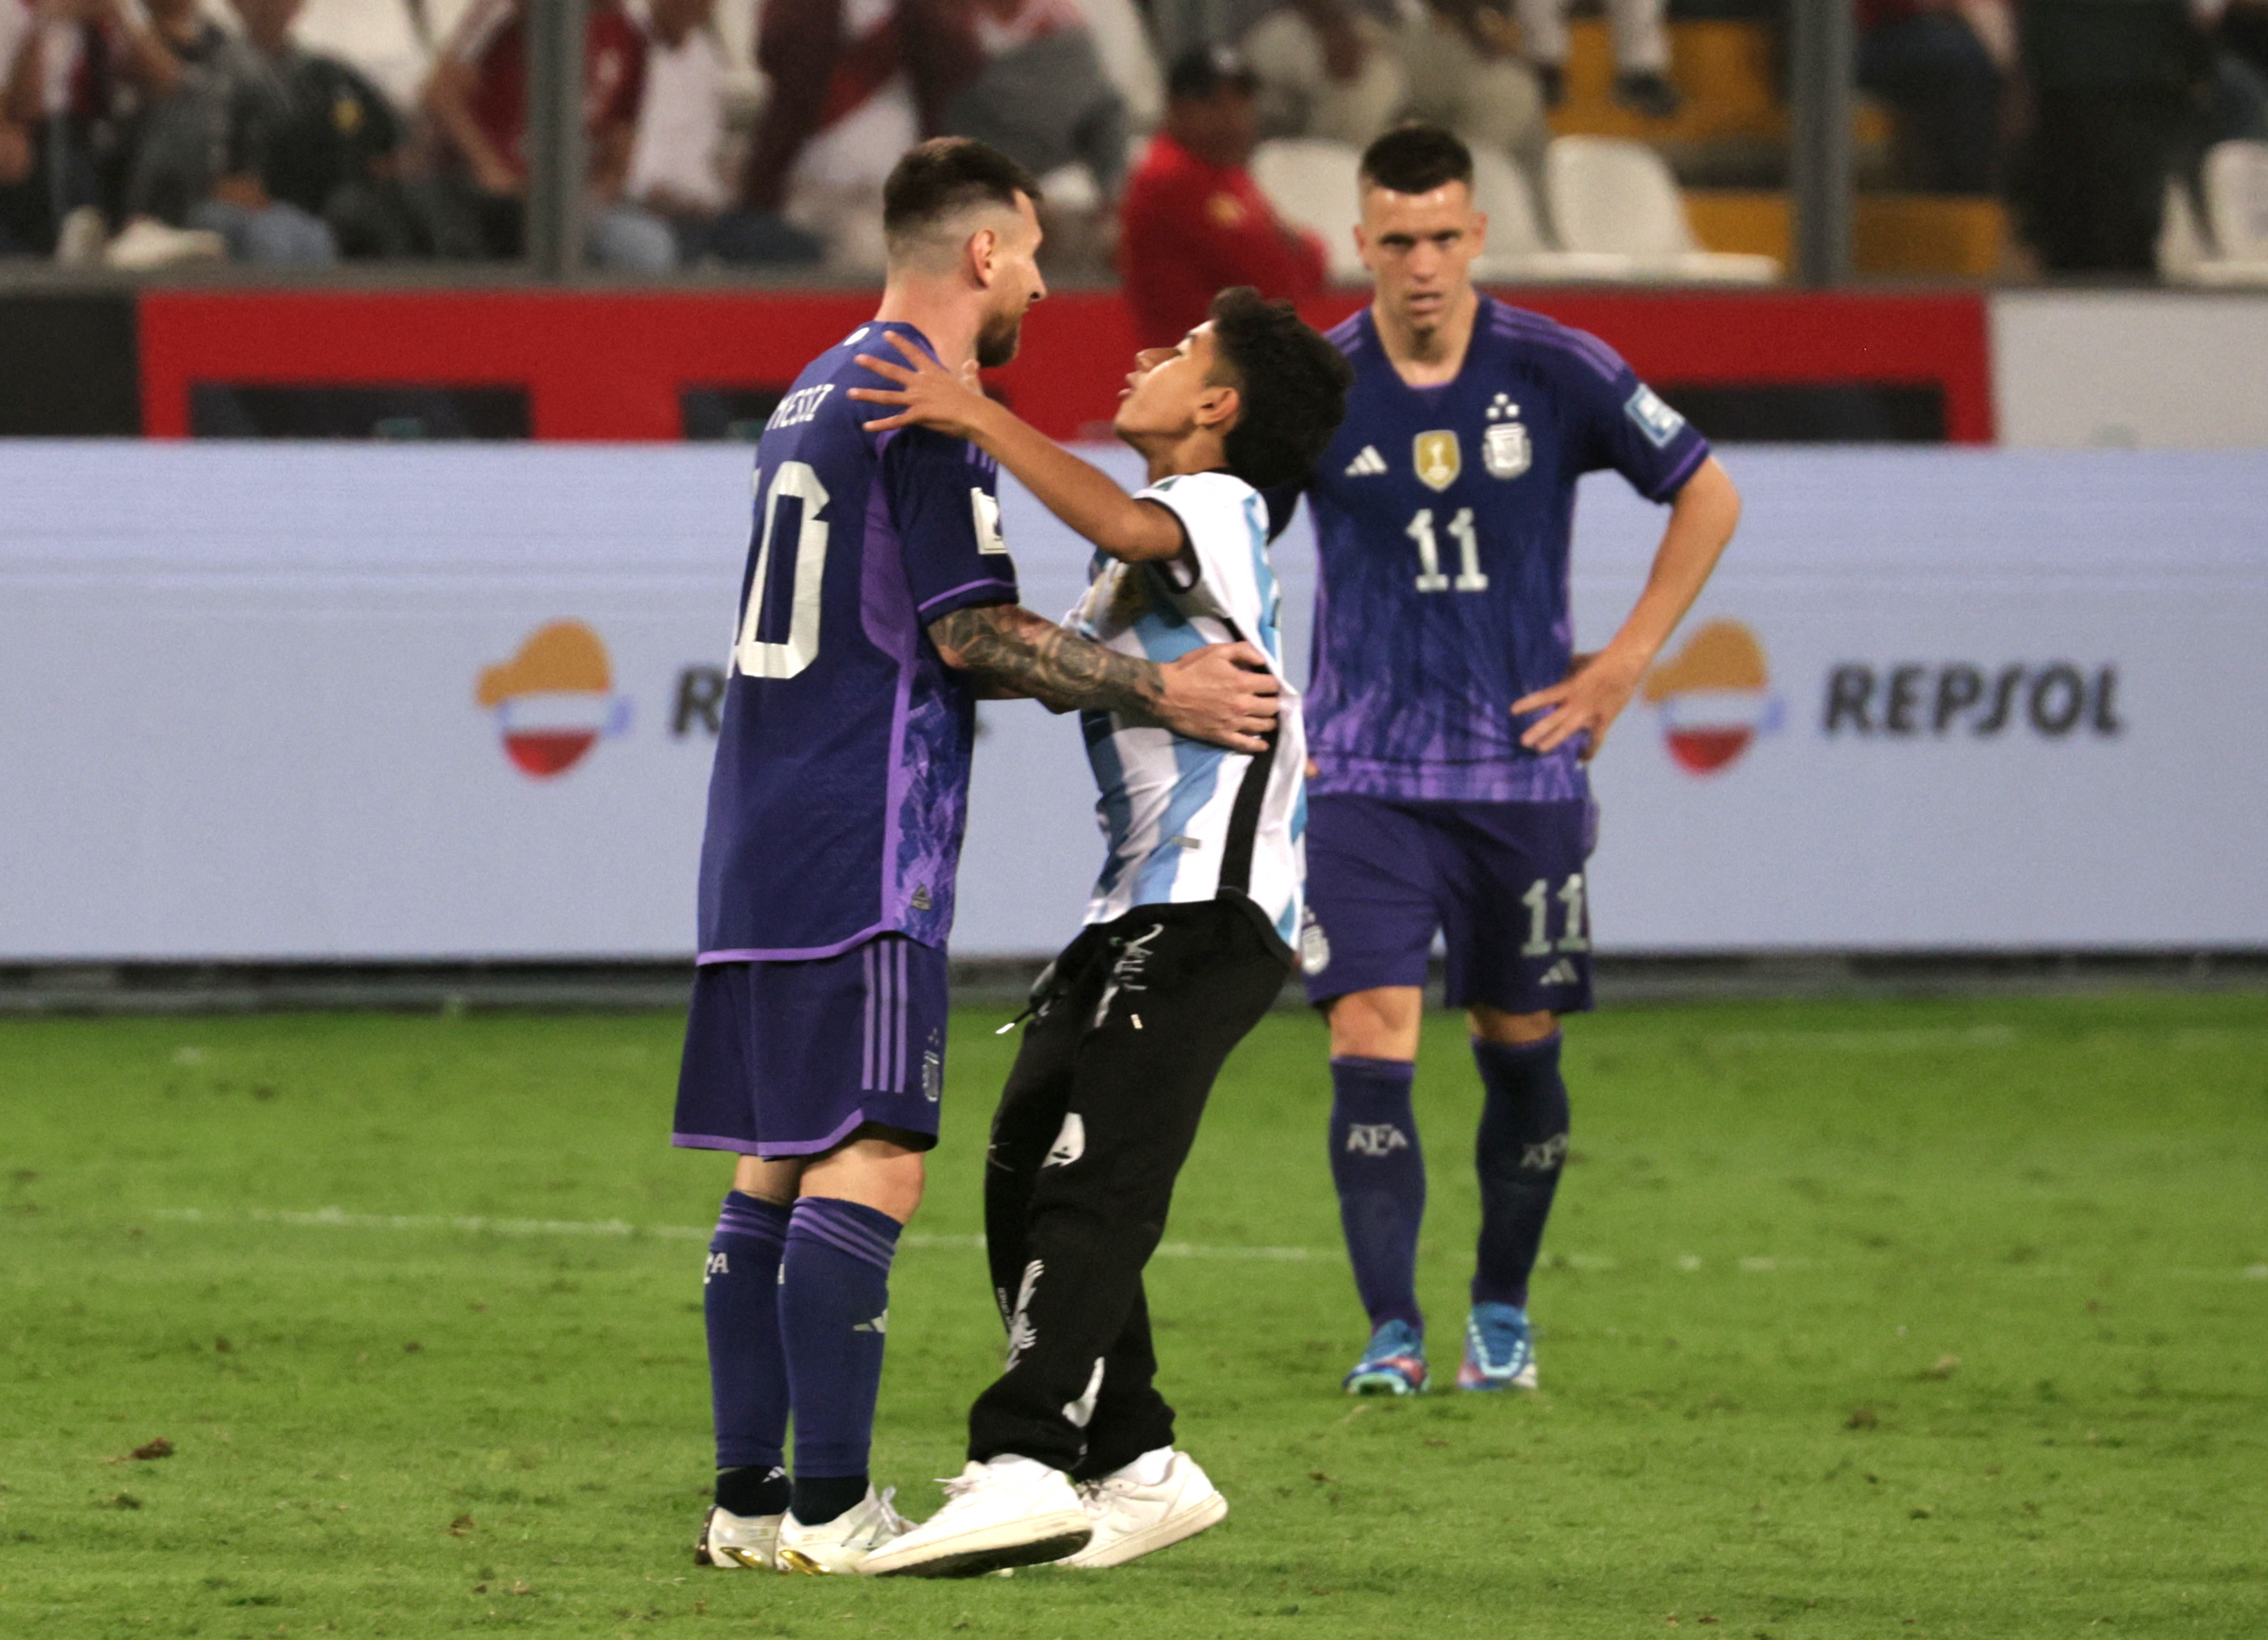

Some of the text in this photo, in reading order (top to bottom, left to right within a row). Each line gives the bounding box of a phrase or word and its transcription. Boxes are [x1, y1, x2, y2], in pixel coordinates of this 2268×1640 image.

[1405, 508, 1489, 591] 11
[1823, 659, 2125, 739] REPSOL
[1521, 873, 1588, 956] 11
[1346, 1124, 1409, 1155] AFA
